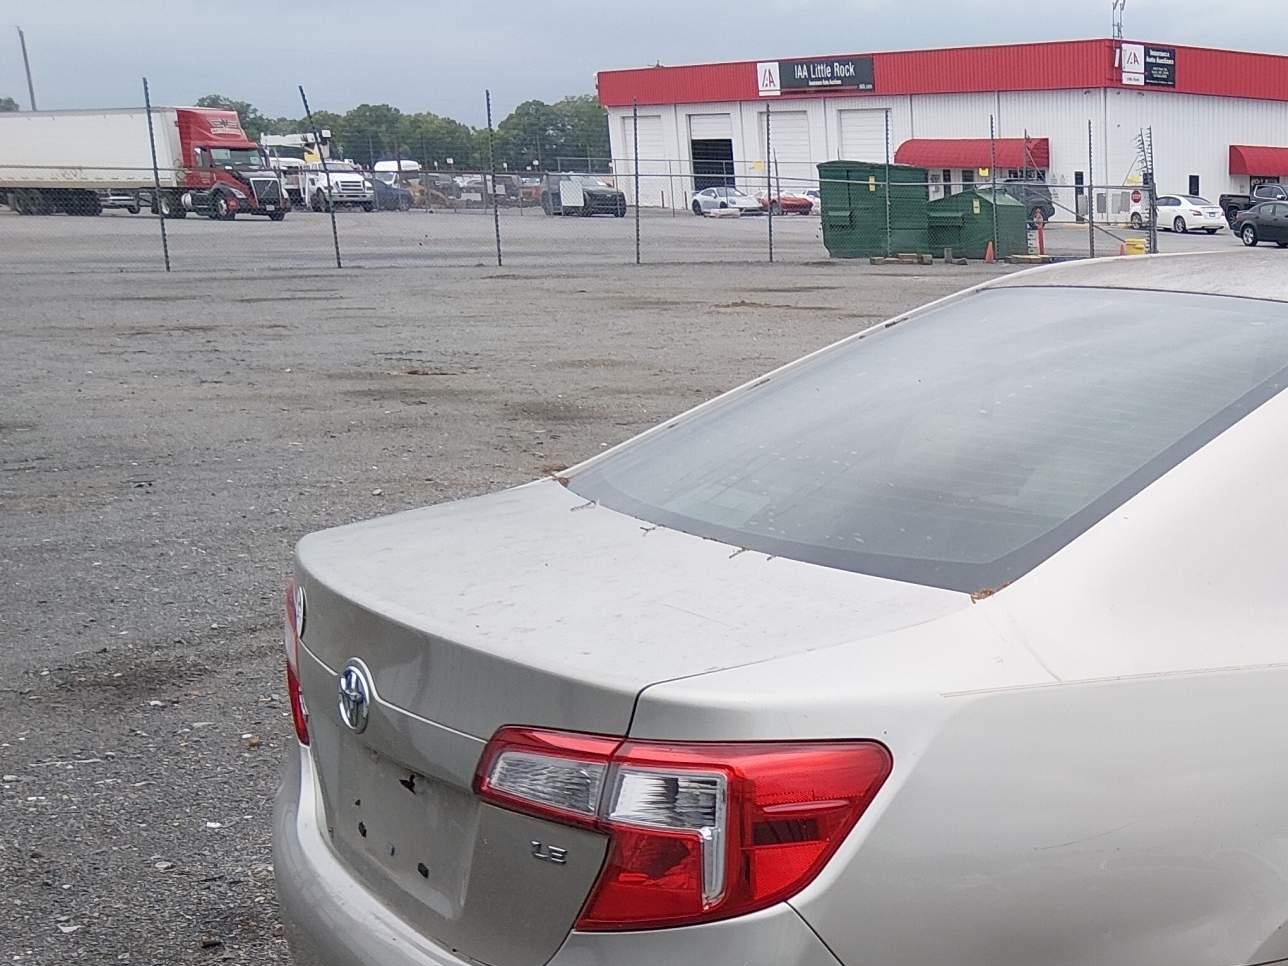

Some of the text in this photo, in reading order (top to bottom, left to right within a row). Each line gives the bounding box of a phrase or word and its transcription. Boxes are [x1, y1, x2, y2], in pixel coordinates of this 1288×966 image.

[795, 61, 855, 79] IAA Little Rock
[531, 840, 567, 864] LE
